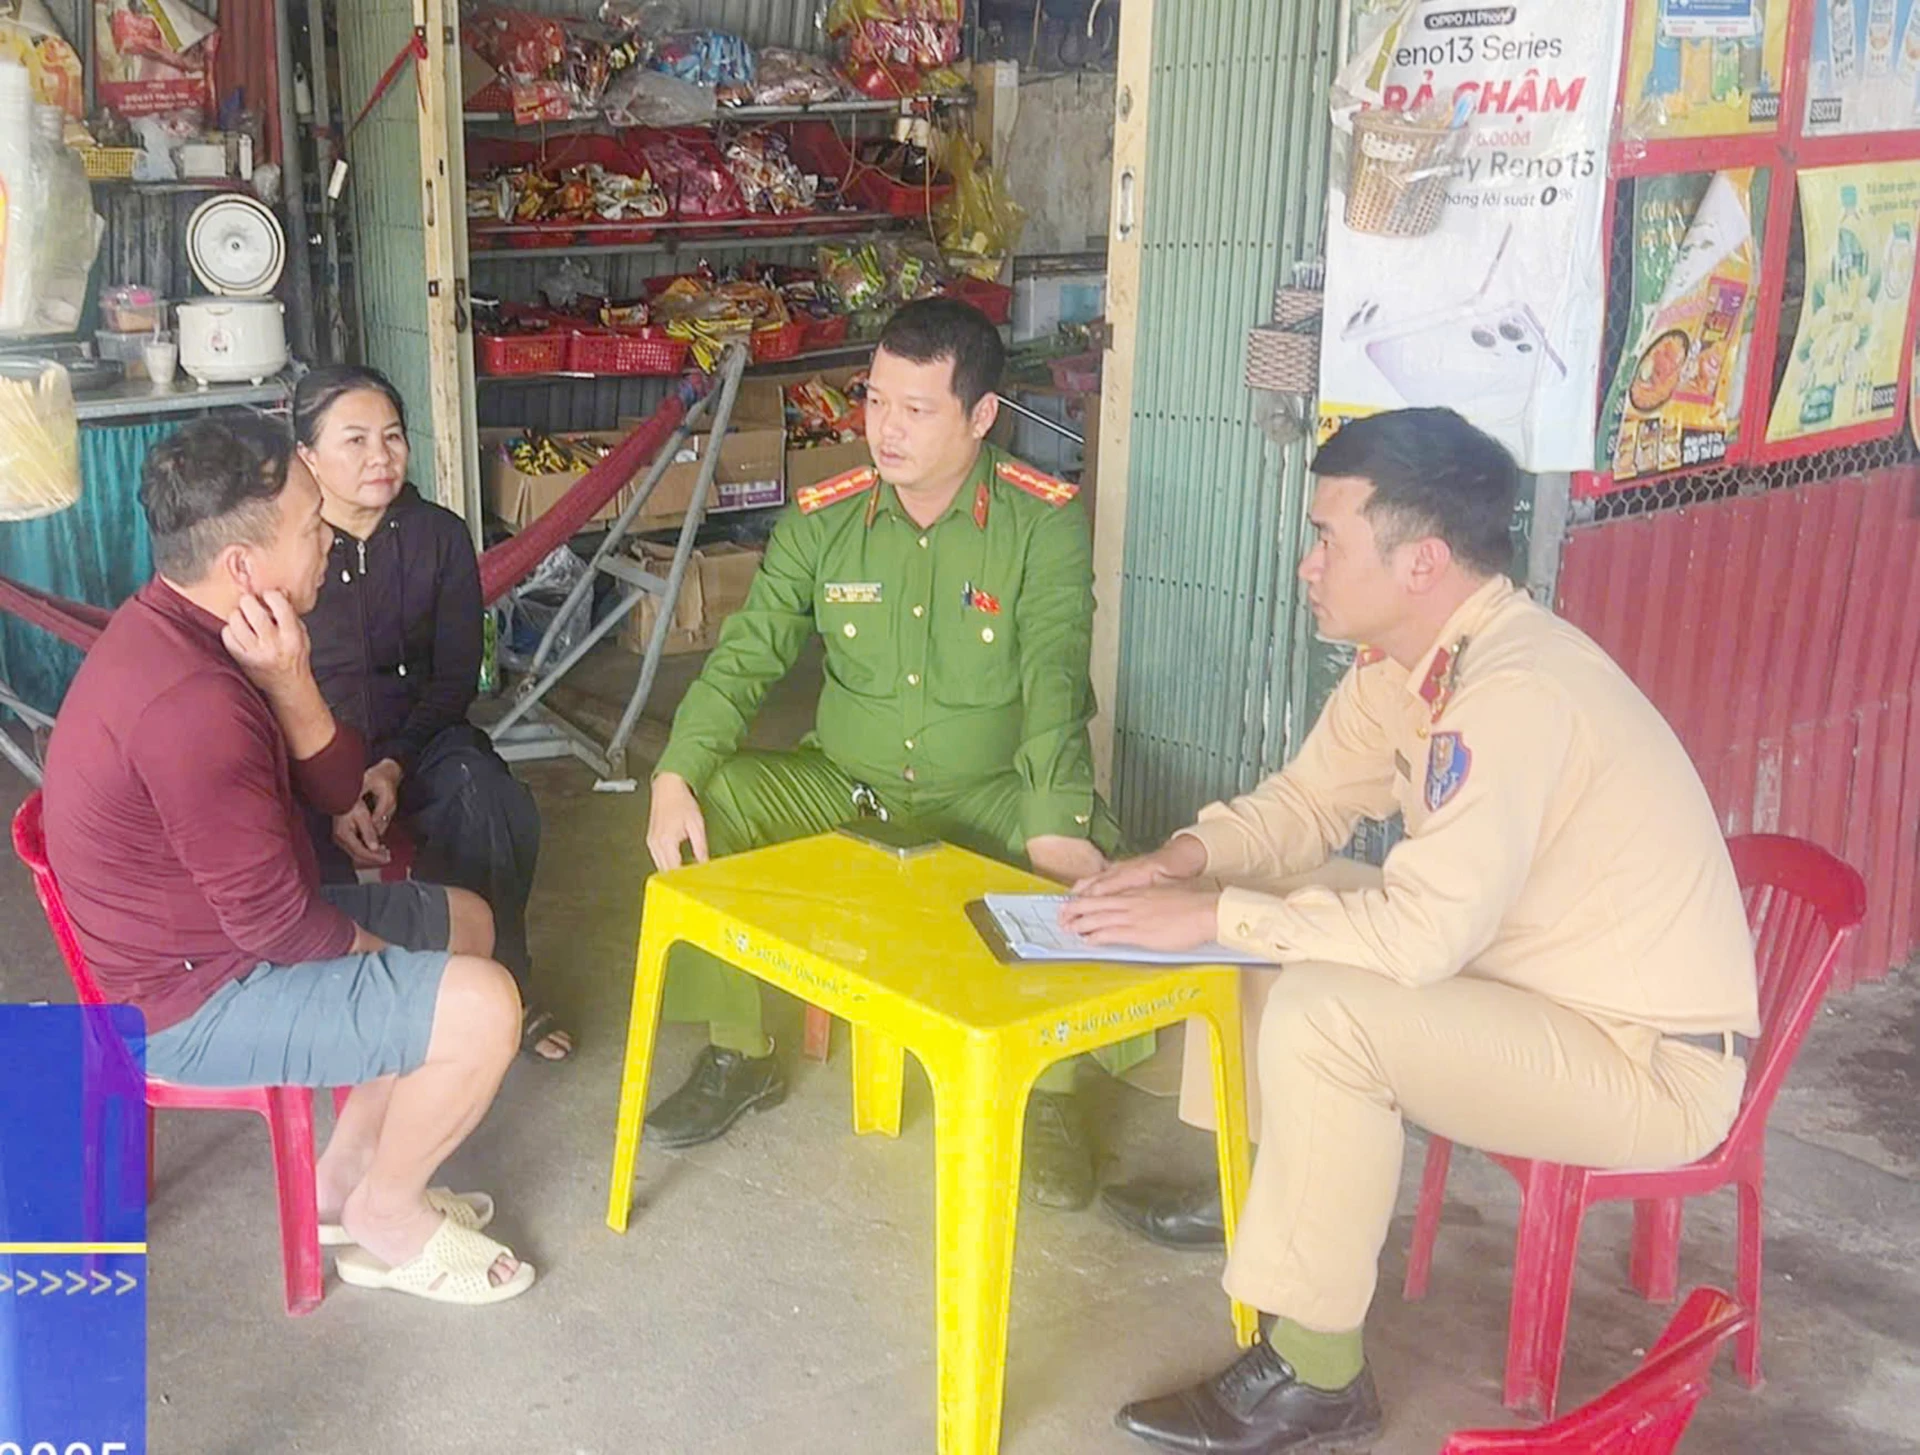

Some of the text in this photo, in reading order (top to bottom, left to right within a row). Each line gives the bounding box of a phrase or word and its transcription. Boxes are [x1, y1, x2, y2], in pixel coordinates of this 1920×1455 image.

[1429, 12, 1464, 28] OPPO
[1392, 33, 1563, 67] eno13 Series
[1360, 68, 1587, 124] RẢ CHẬM
